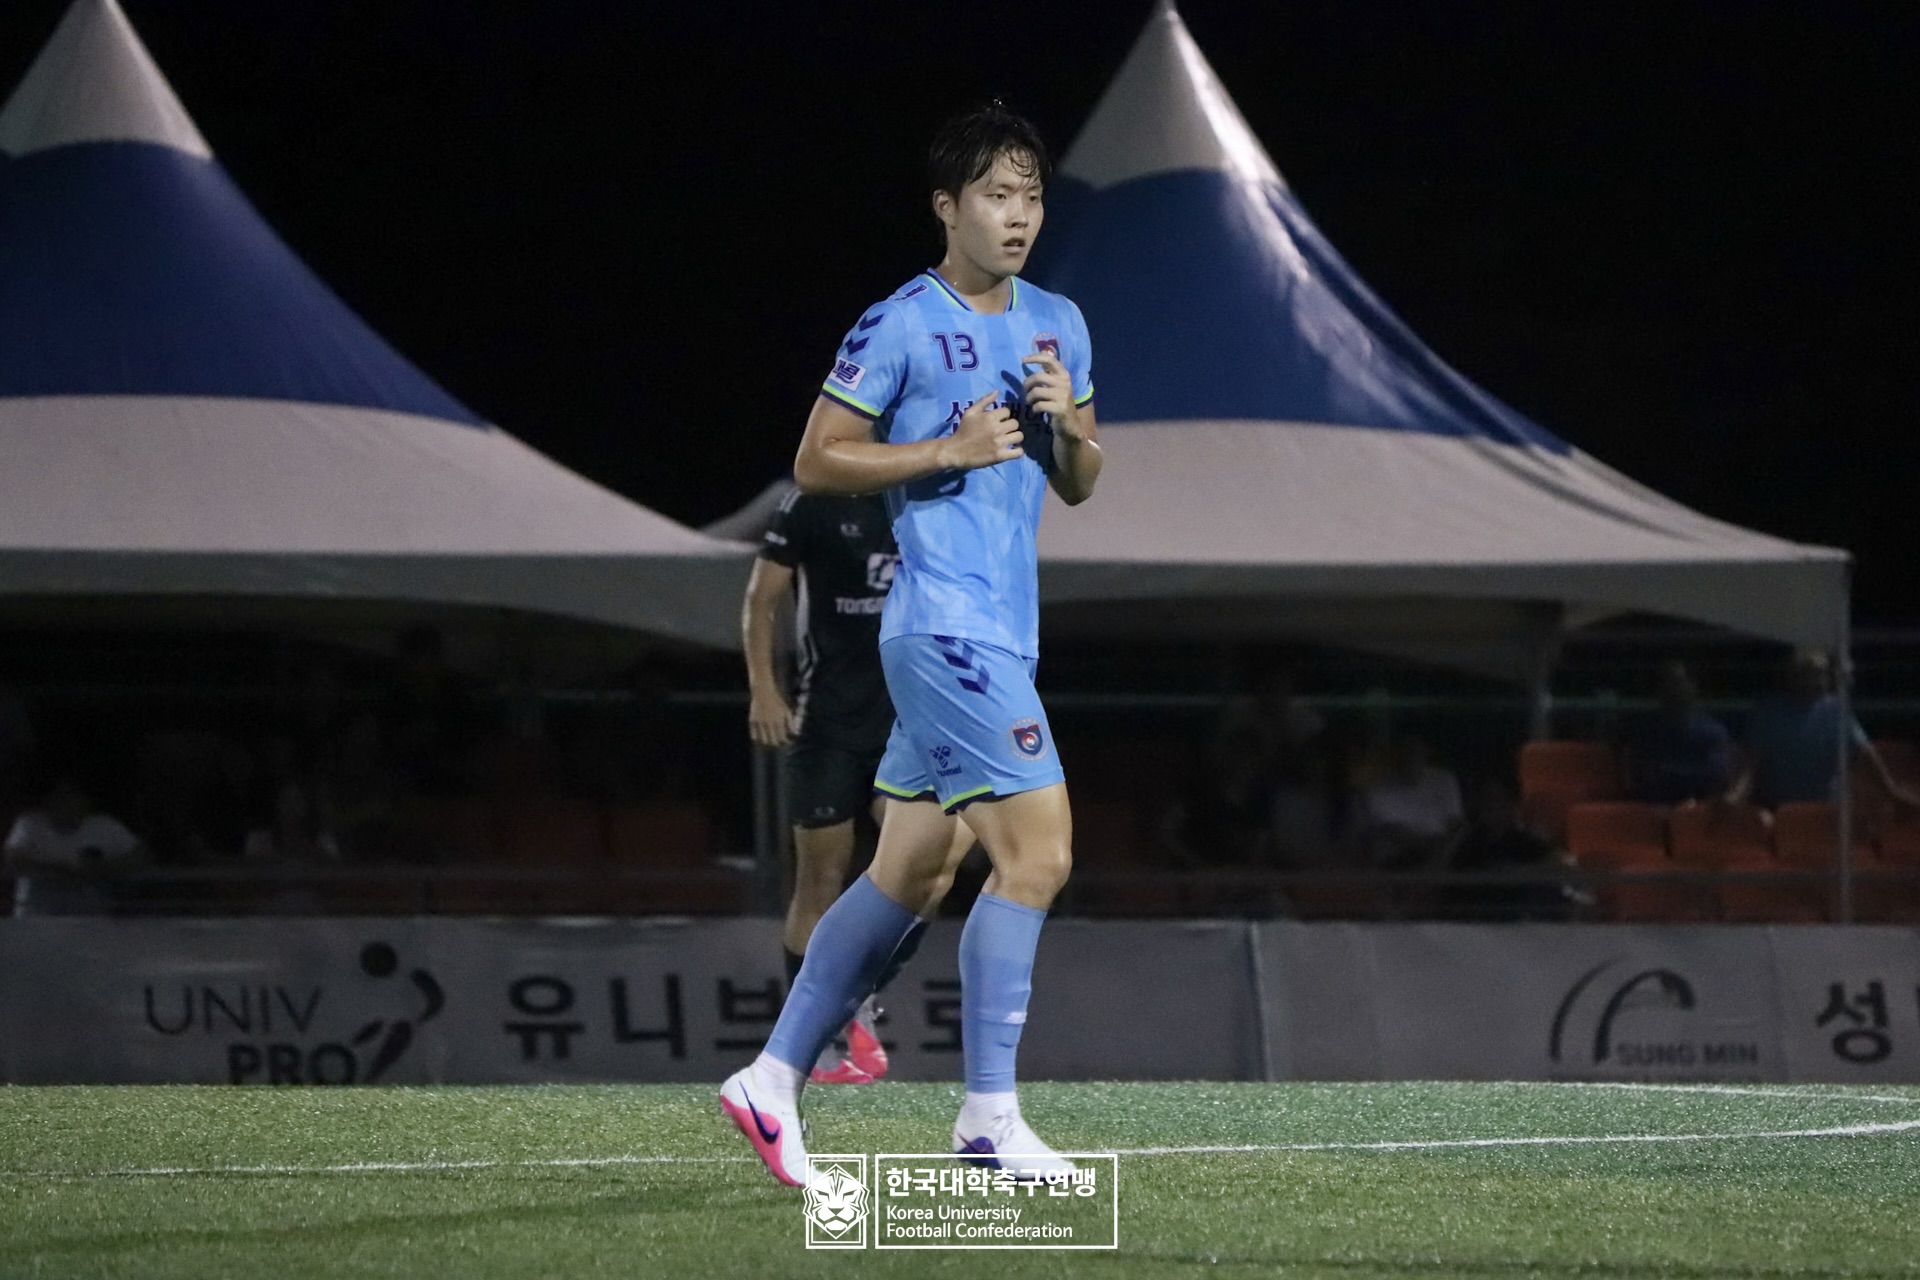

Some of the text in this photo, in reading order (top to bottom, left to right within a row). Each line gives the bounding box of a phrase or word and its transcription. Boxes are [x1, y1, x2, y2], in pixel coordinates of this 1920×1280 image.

[932, 332, 979, 372] 13
[145, 985, 320, 1035] UNIV
[1816, 980, 1920, 1065] 성
[227, 1043, 357, 1084] PRO
[1617, 1043, 1758, 1065] SUNG MIN
